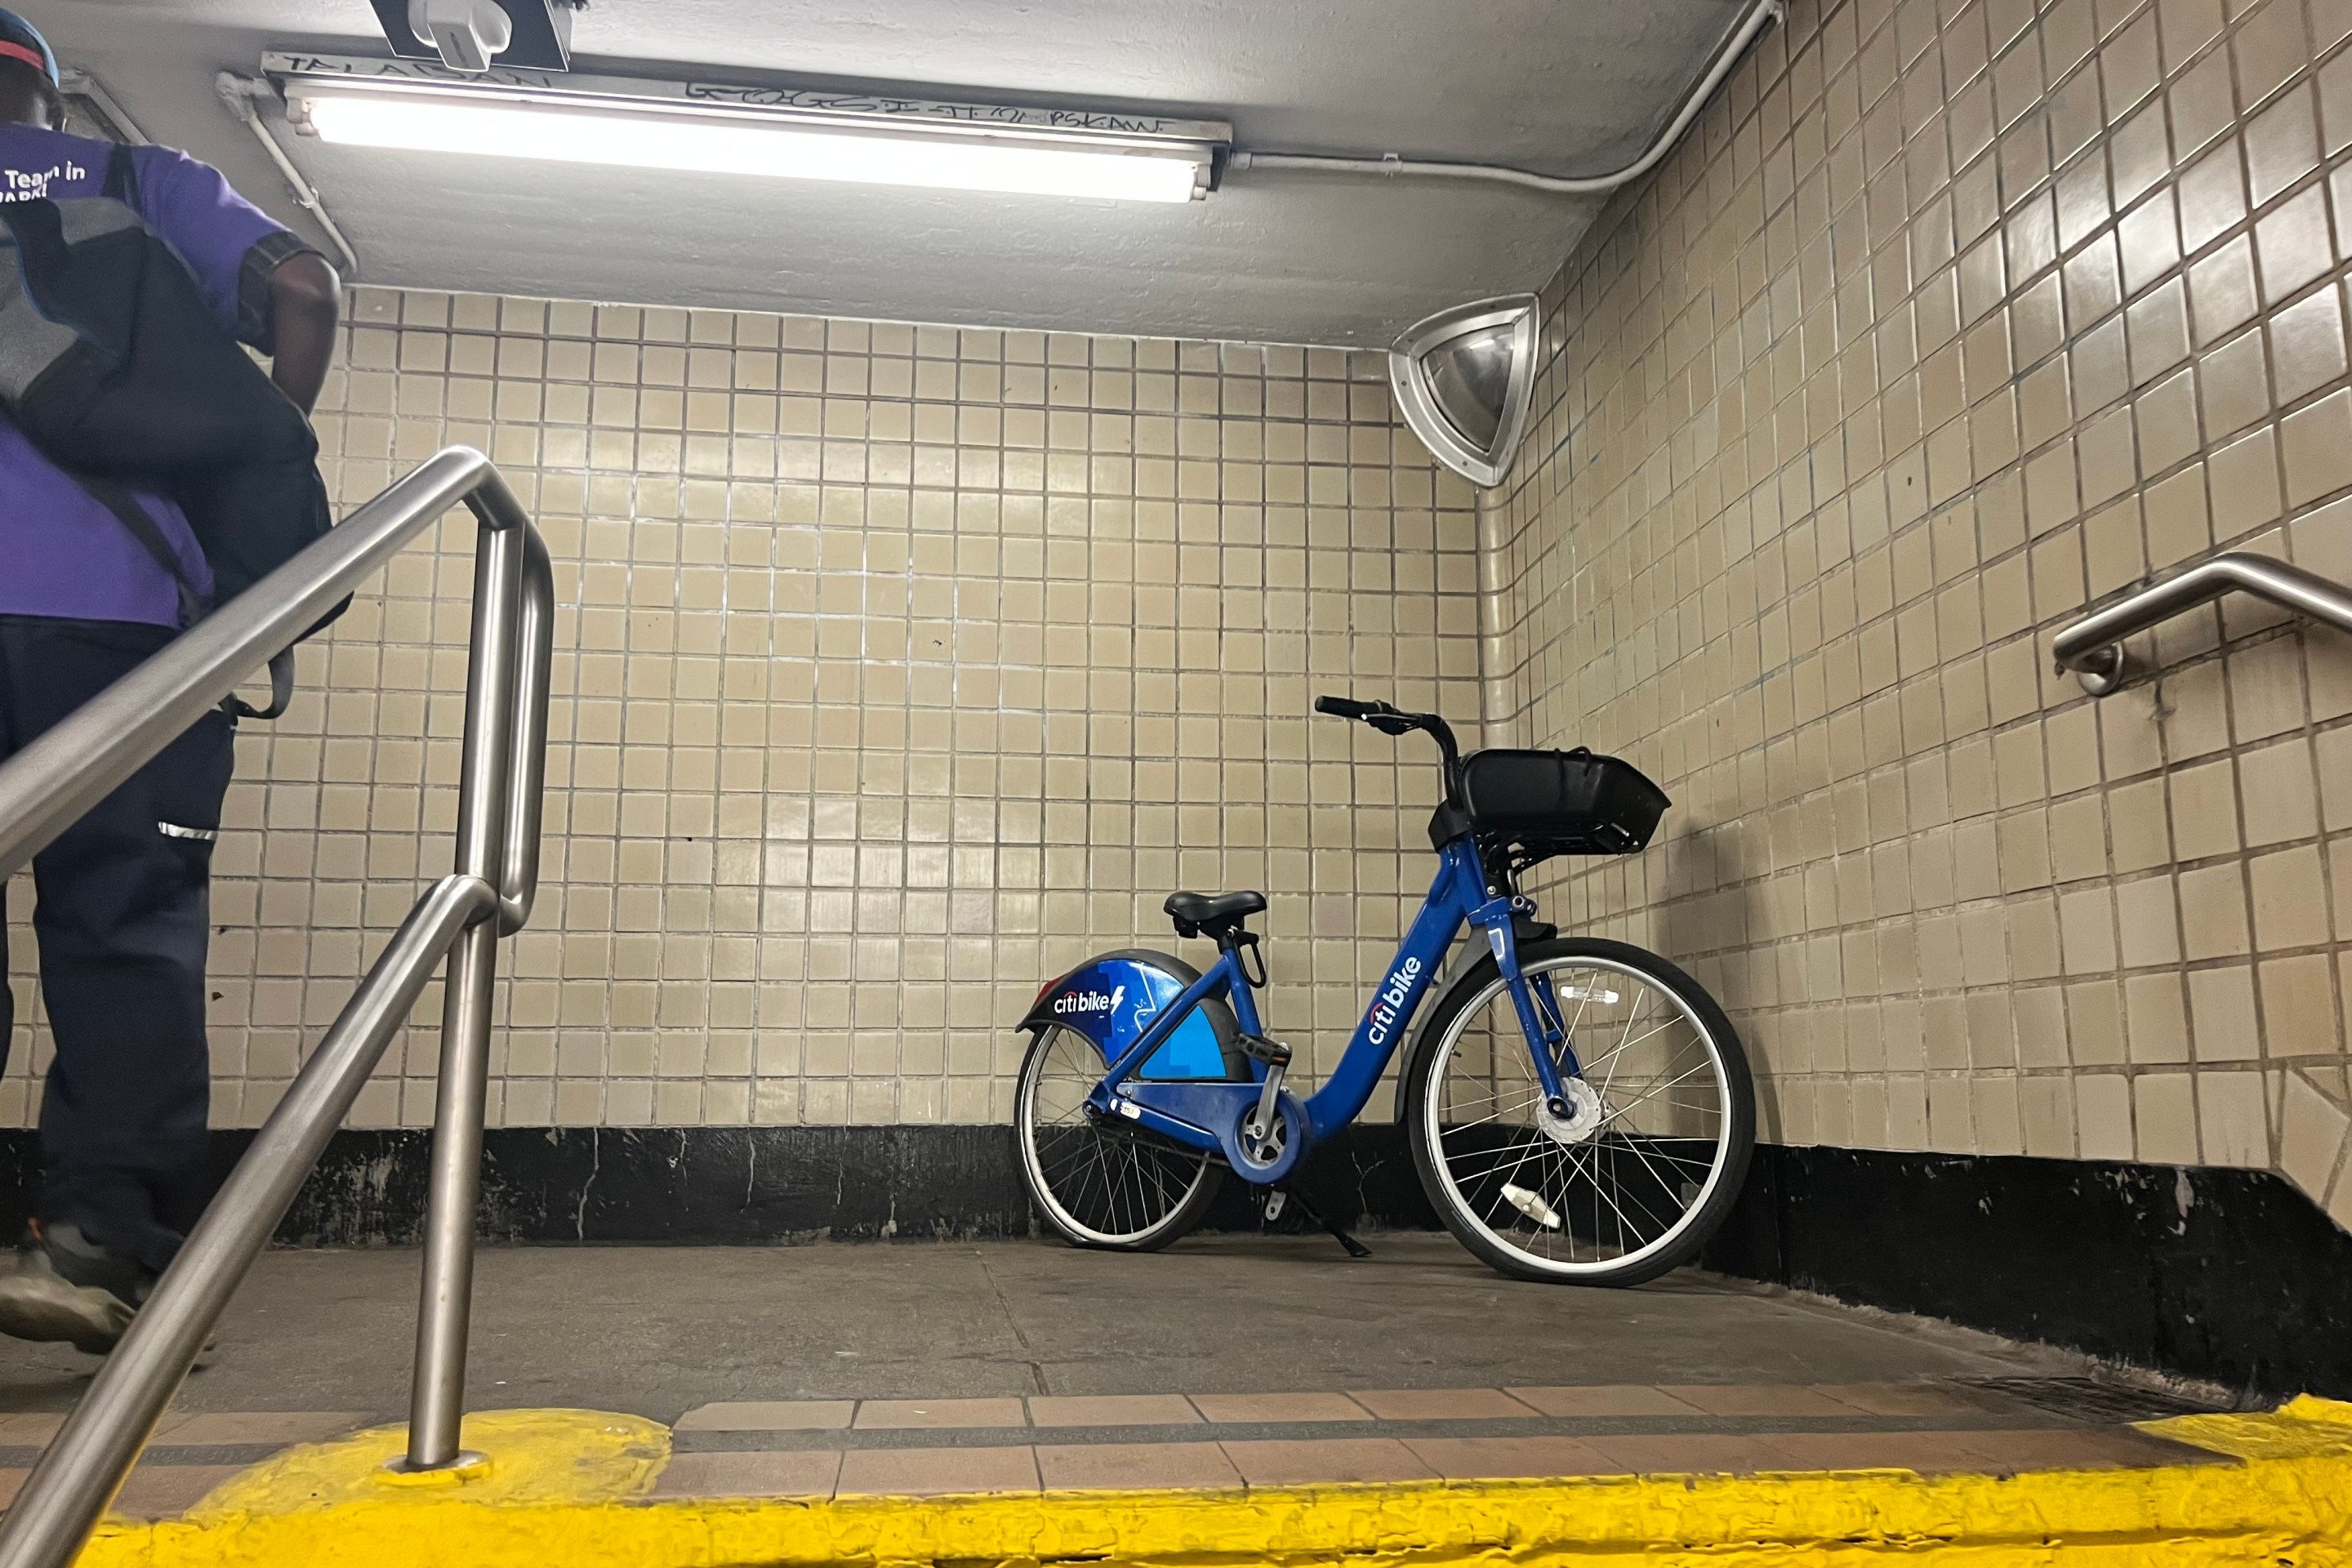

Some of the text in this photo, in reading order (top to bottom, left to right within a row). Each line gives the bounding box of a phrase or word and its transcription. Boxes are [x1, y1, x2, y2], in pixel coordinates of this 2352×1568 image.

[4, 160, 86, 189] Team in
[1054, 991, 1110, 1013] citi bike
[1368, 956, 1422, 1045] citi bike
